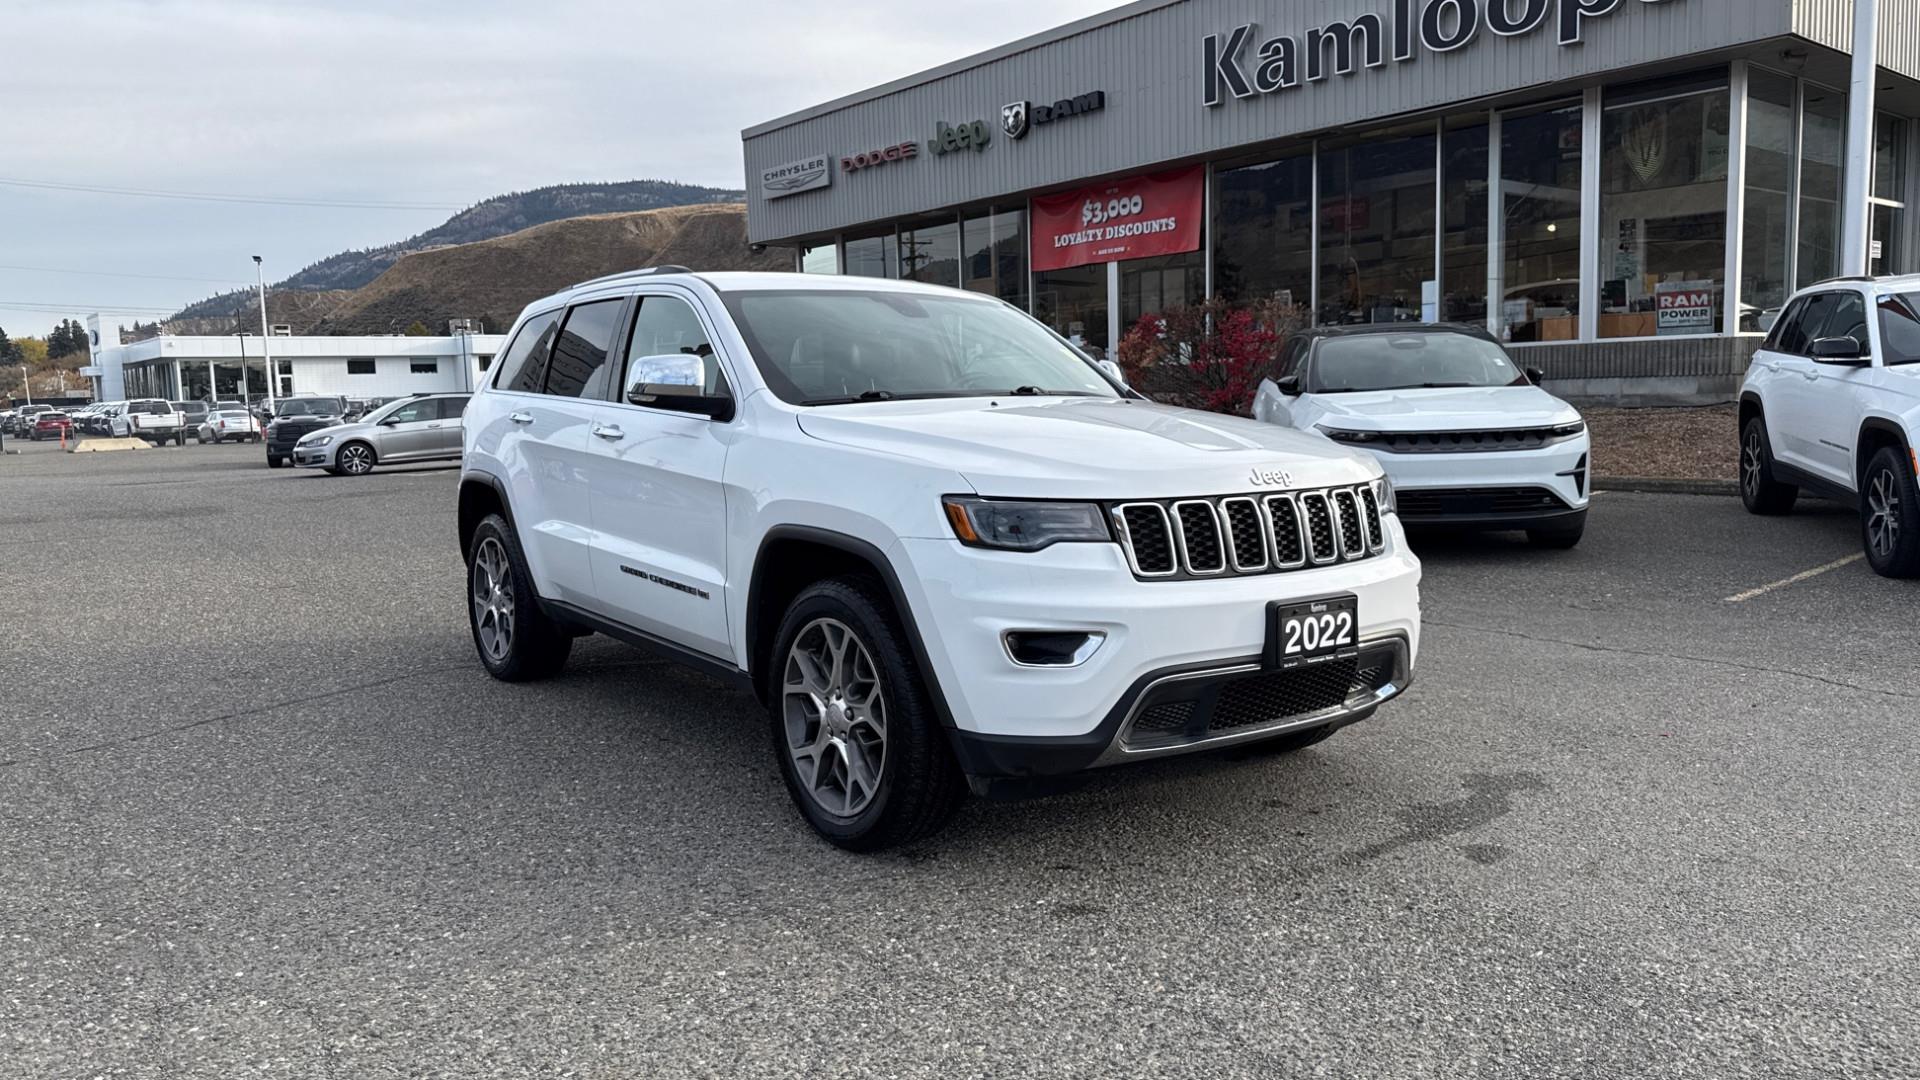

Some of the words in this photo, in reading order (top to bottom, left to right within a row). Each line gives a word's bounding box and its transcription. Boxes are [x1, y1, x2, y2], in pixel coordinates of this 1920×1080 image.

[1202, 0, 1672, 106] Kamloop
[1030, 90, 1105, 124] RAM
[928, 120, 989, 156] Jeep
[763, 159, 825, 182] CHRYSLER
[840, 141, 918, 173] DODGE
[1082, 195, 1143, 226] $3,000
[1054, 227, 1105, 248] LOYALTY
[1105, 217, 1176, 240] DISCOUNTS
[1660, 293, 1708, 308] RAM
[1661, 308, 1708, 319] POWER
[1250, 467, 1292, 488] Jeep
[1285, 611, 1352, 654] 2022
